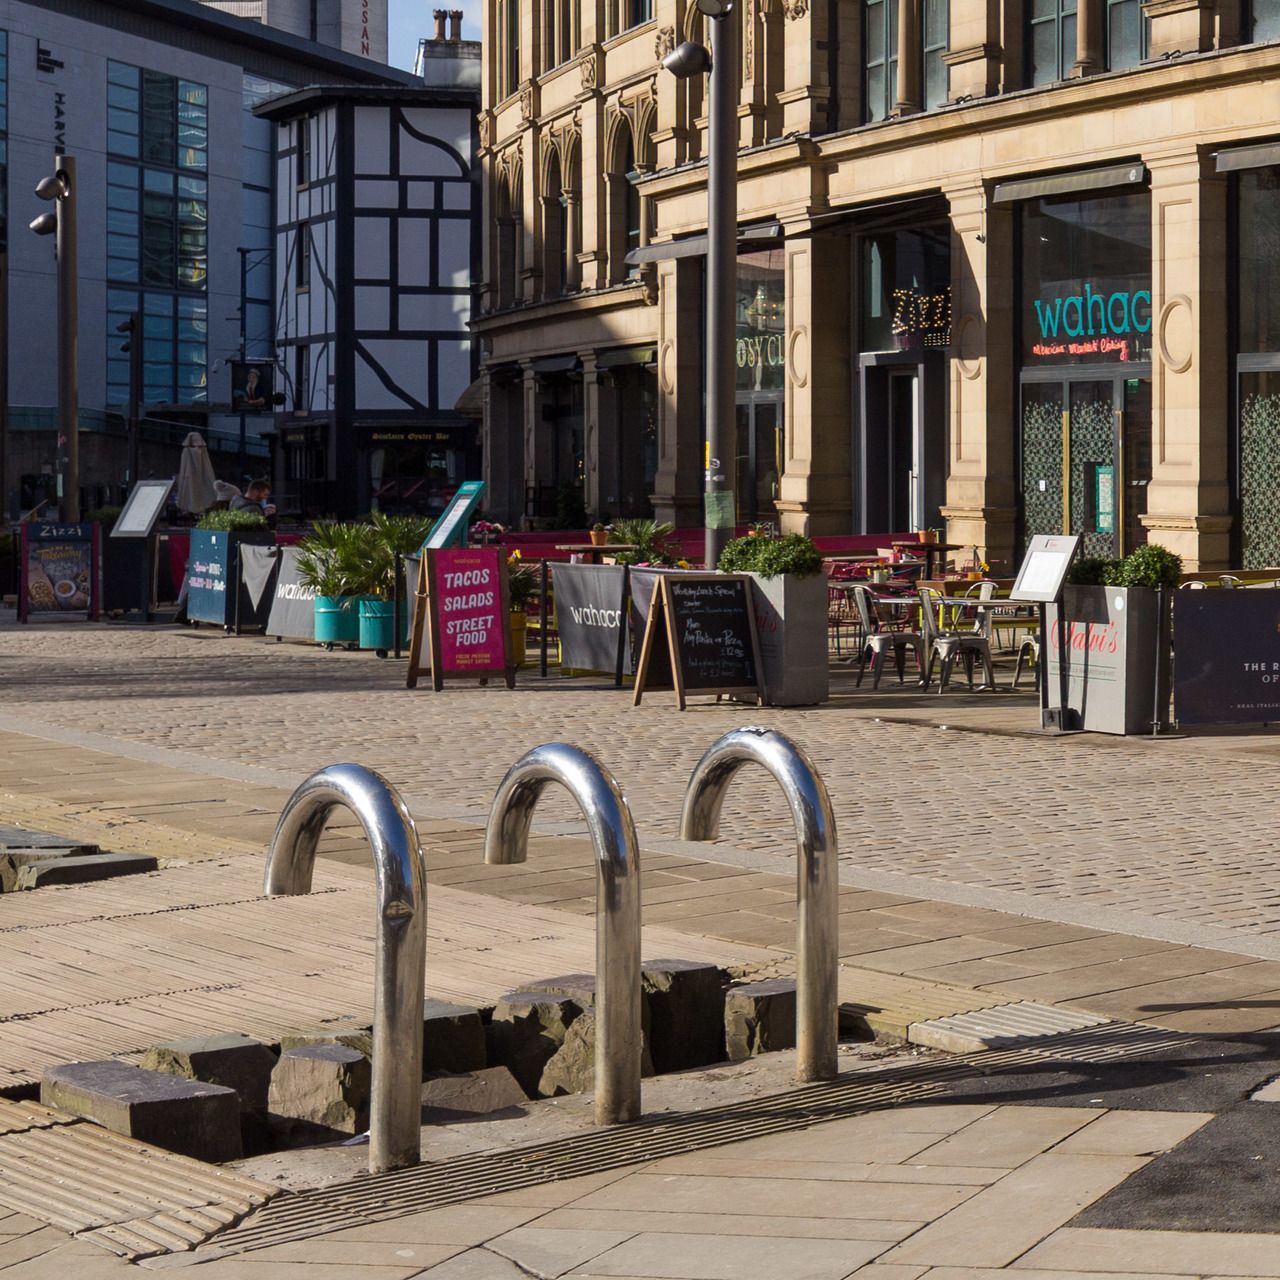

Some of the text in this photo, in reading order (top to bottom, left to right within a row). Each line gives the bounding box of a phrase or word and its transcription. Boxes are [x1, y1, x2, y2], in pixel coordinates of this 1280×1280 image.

[1034, 283, 1152, 337] wahac
[736, 336, 764, 368] OSY
[40, 524, 82, 537] Zizzi
[444, 569, 491, 589] TACOS
[444, 592, 494, 612] SALADS
[446, 616, 494, 635] STREET
[456, 631, 487, 647] FOOD
[1243, 662, 1267, 671] THE
[1261, 674, 1280, 683] OF
